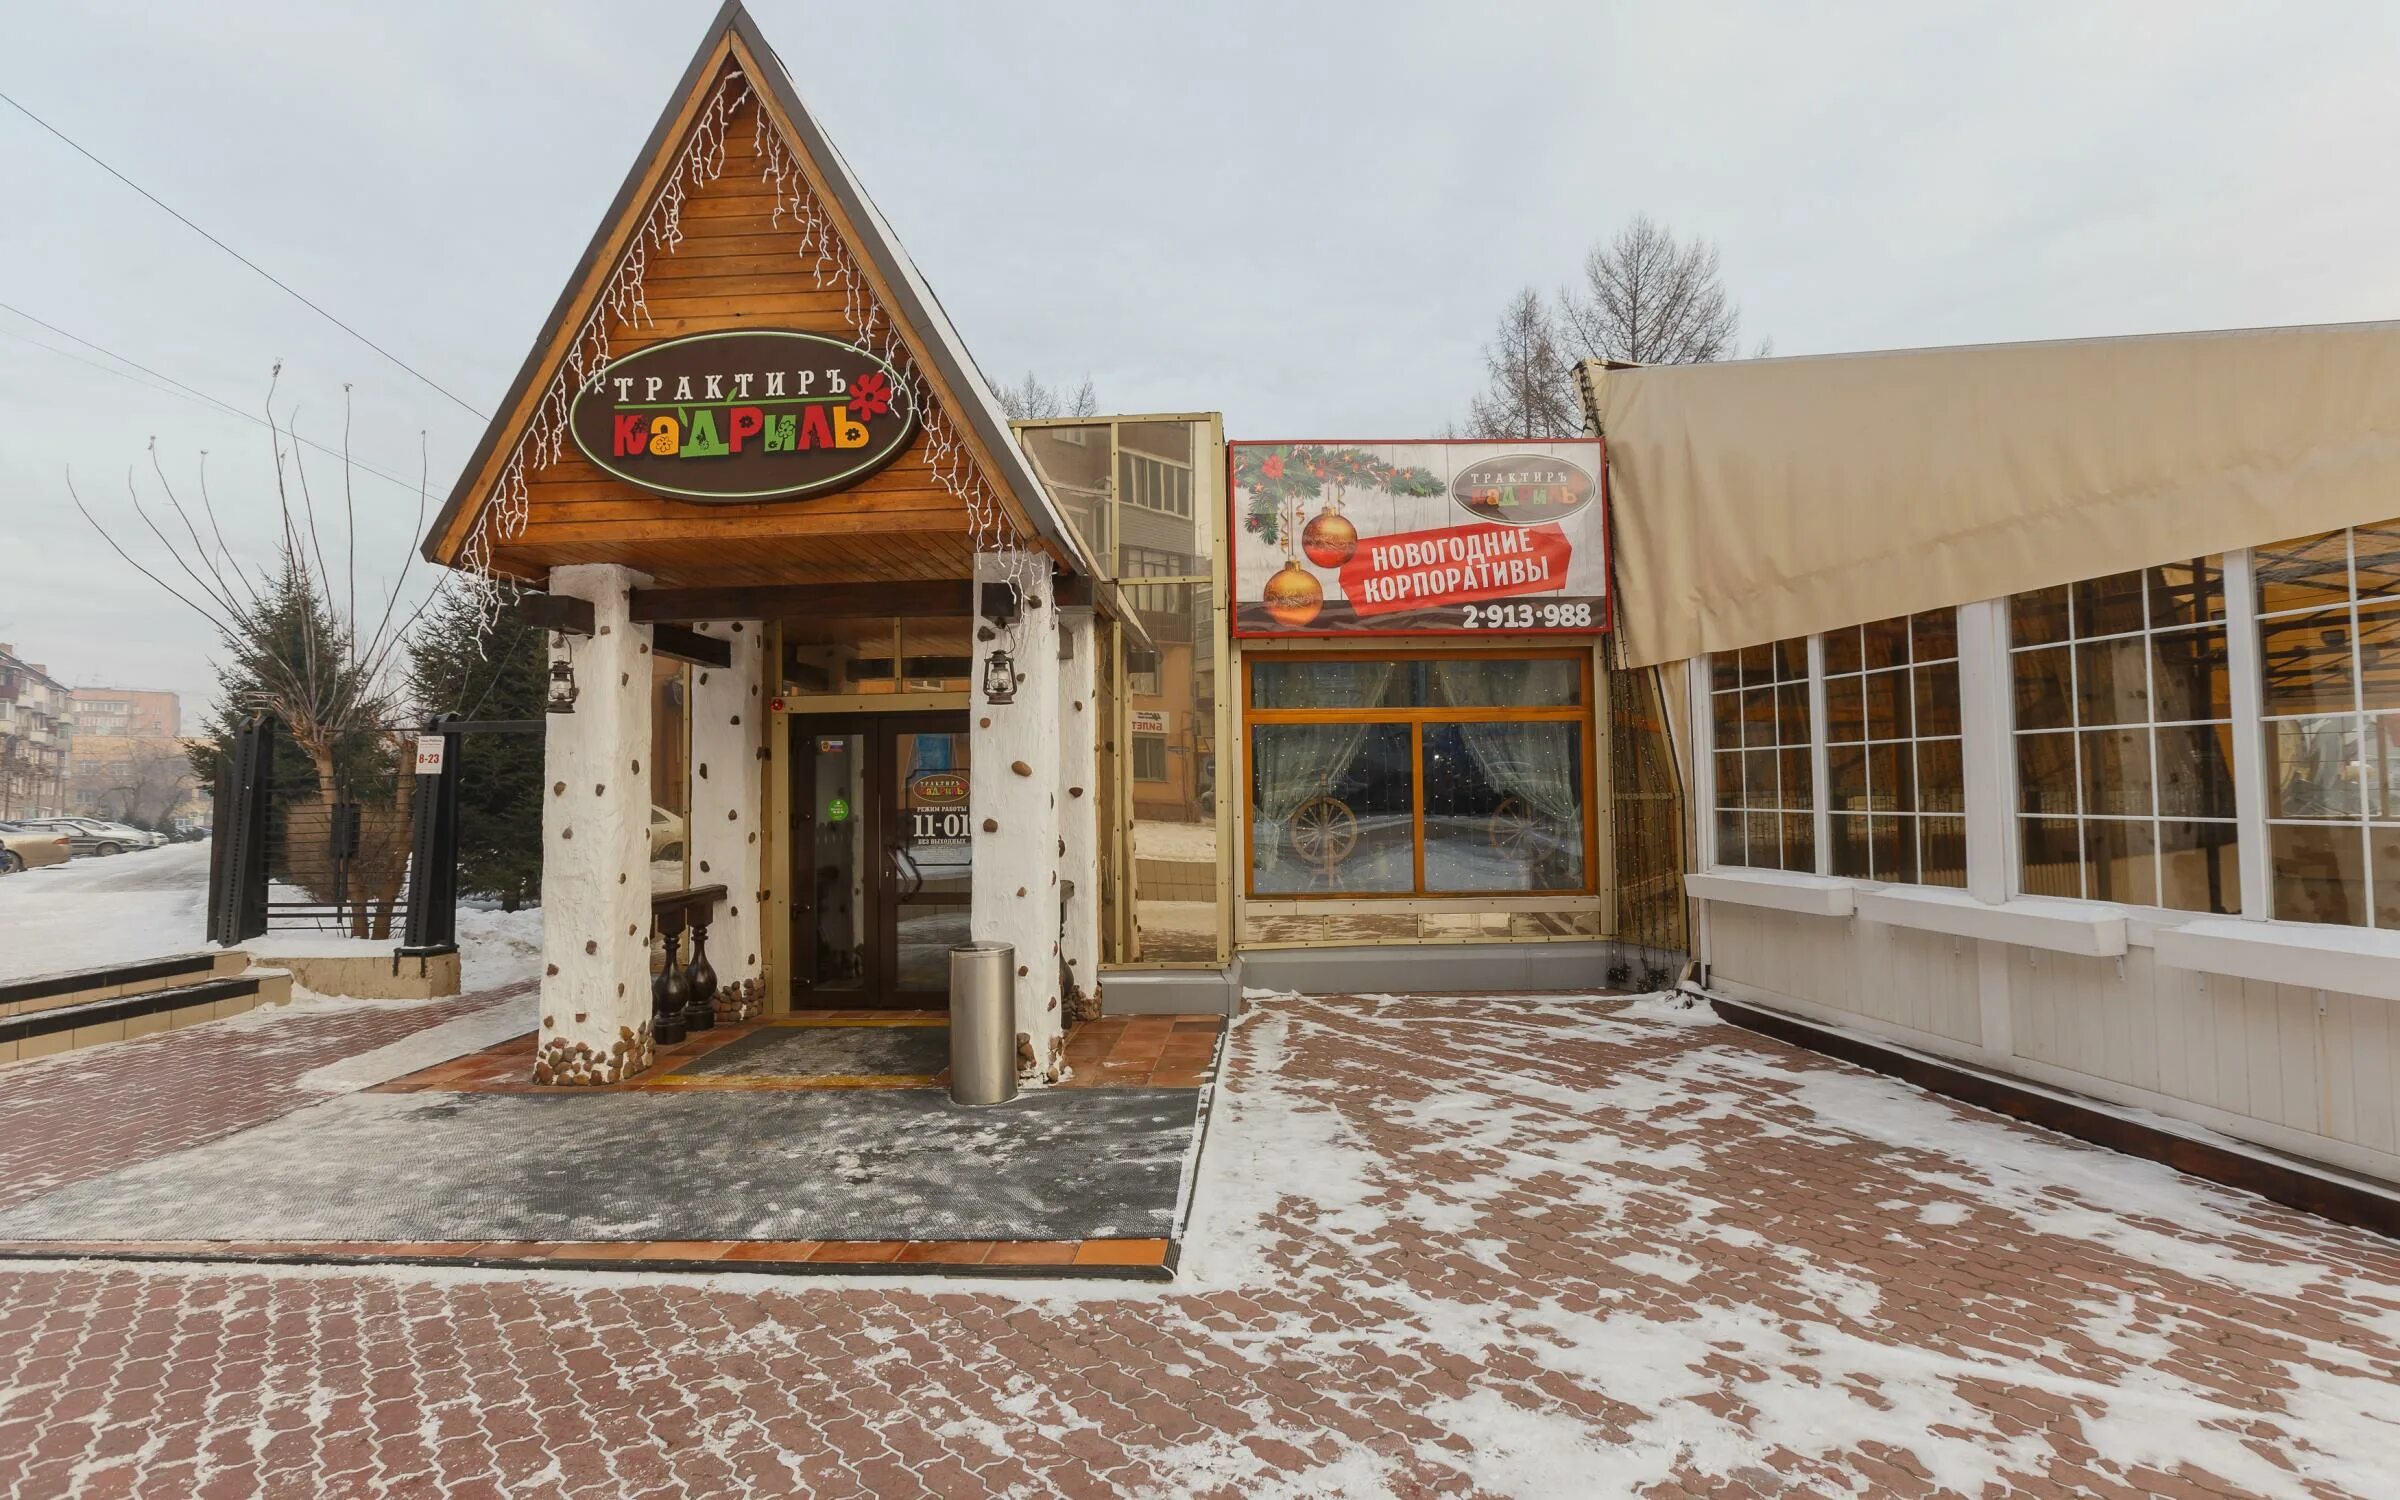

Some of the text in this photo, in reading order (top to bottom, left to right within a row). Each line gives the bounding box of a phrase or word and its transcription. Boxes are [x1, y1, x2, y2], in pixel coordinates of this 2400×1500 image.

[613, 368, 847, 402] ТРАКТИРЪ
[1470, 471, 1568, 484] ТРАКТИРЪ
[1371, 527, 1534, 572] НОВОГОДНИЕ
[1363, 556, 1550, 604] КОРПОРАТИВЫ
[418, 753, 440, 764] 8-23
